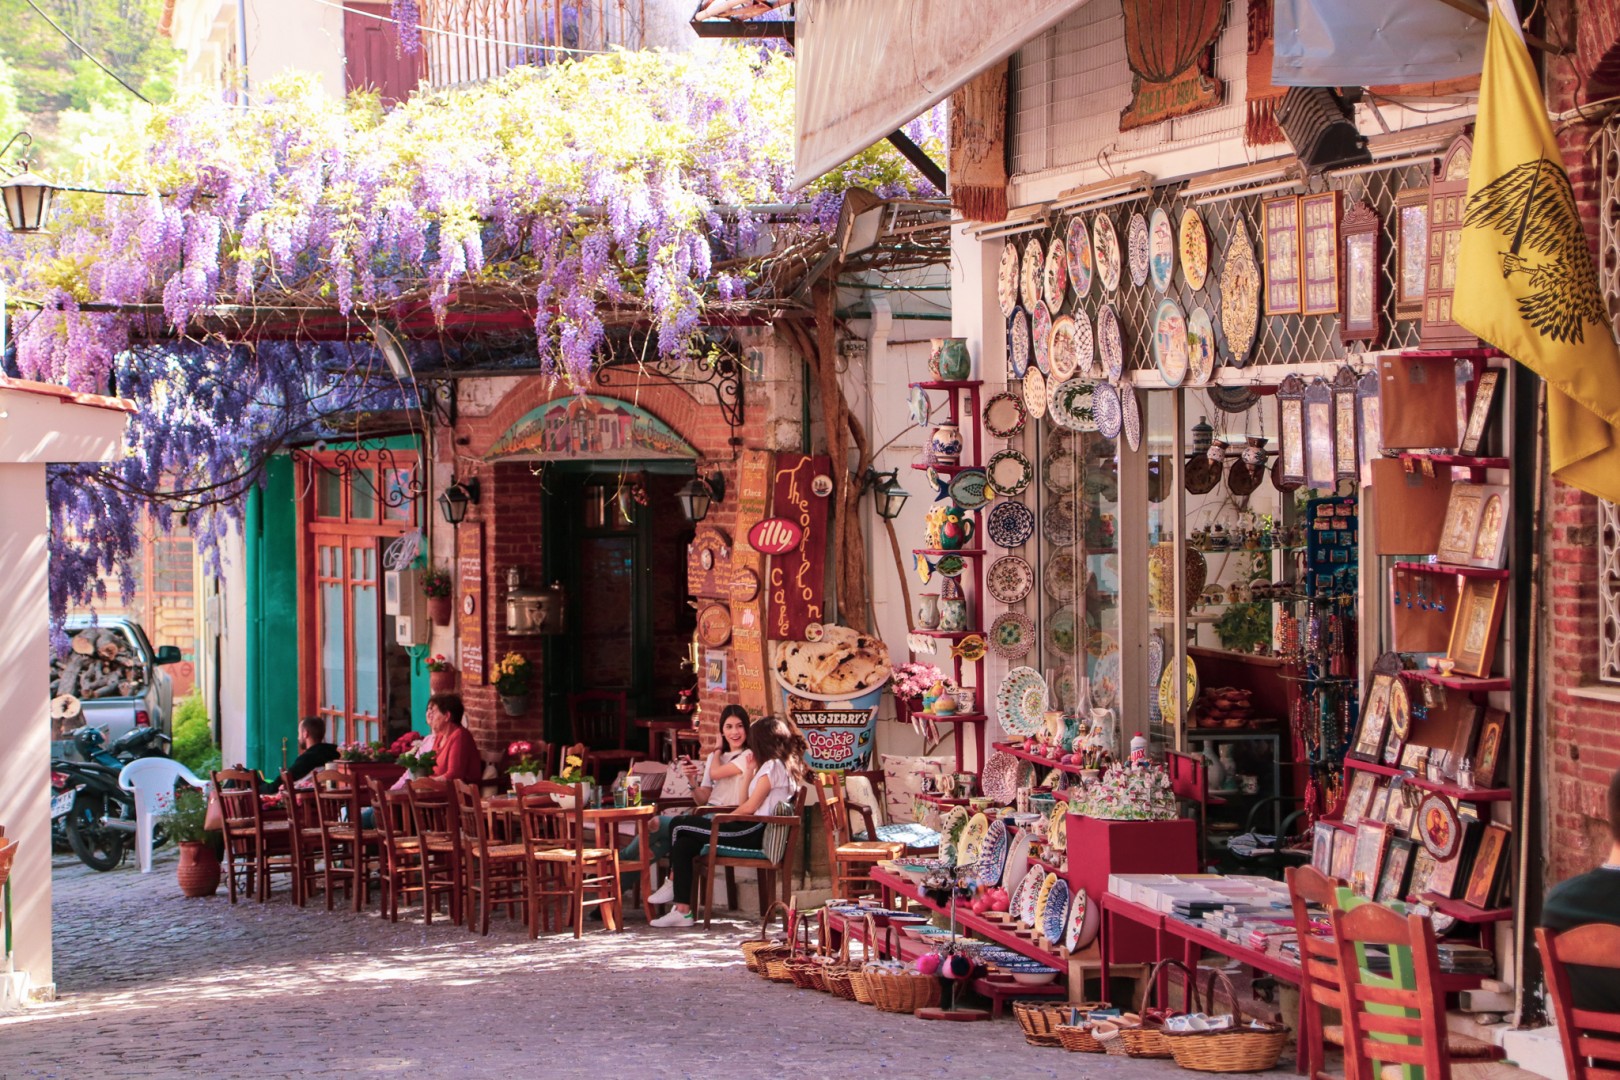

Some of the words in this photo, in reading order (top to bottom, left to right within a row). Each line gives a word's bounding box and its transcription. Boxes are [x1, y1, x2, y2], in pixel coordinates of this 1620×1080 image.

[758, 521, 793, 551] illy
[776, 456, 822, 619] Theofilon
[771, 568, 790, 637] Café
[808, 731, 855, 748] Cookie
[811, 761, 823, 769] ICE
[824, 760, 852, 769] CREAM
[812, 746, 852, 760] Dough
